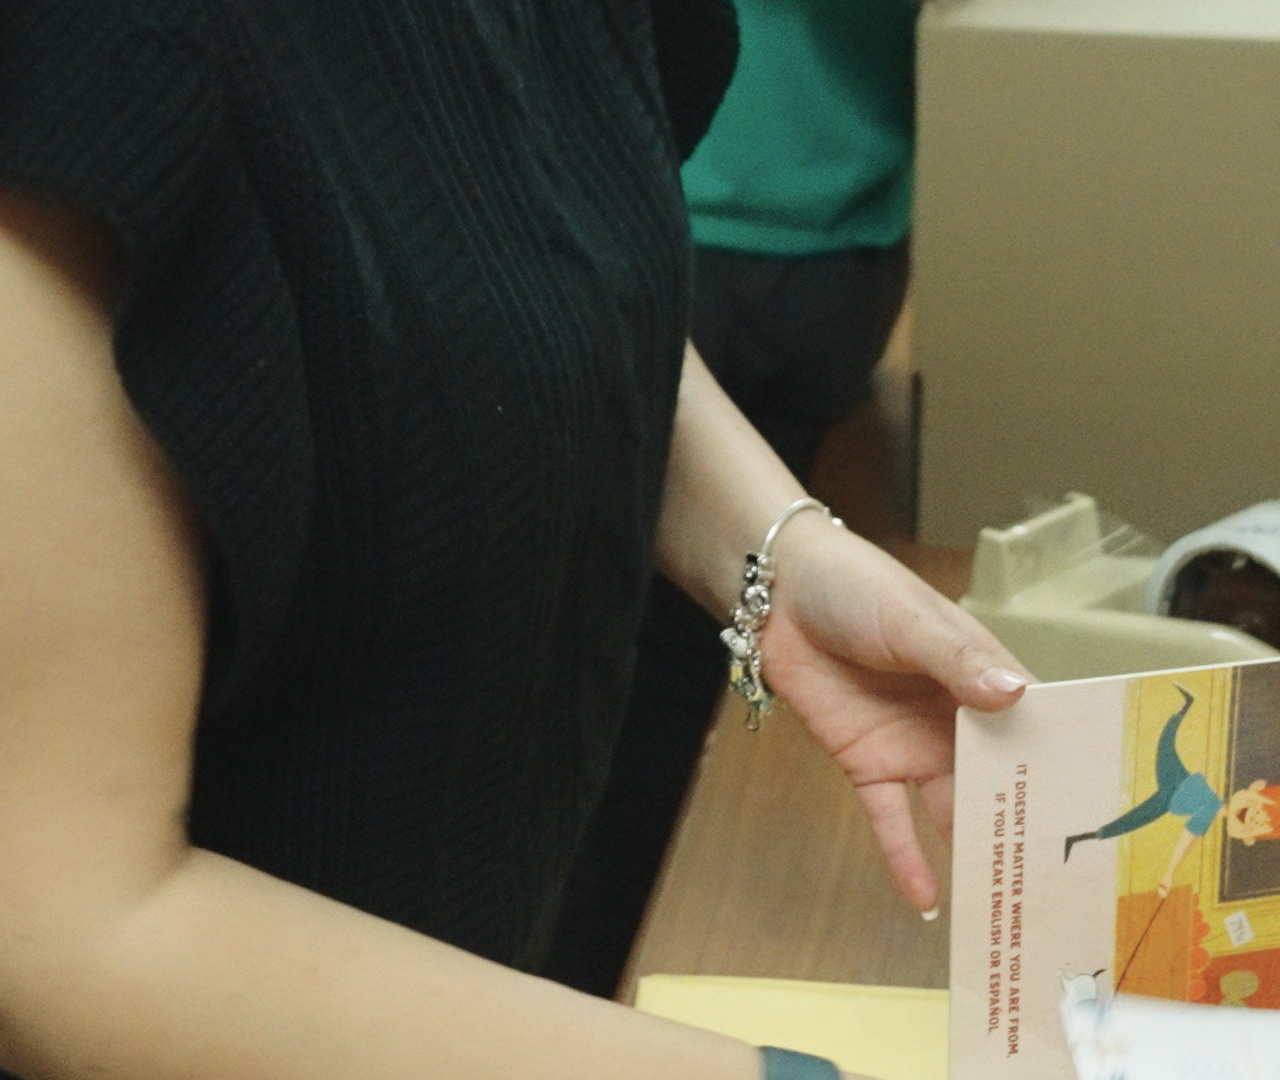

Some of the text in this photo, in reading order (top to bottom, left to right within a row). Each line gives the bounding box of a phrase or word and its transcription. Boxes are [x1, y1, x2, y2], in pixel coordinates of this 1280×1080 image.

[994, 792, 1006, 804] IF
[993, 810, 1006, 838] YOU
[991, 842, 1005, 887] SPEAK
[990, 891, 1003, 946] ENGLISH
[1006, 763, 1027, 1059] IT DOESN'T MATTER WHERE YOU ARE FROM,
[989, 950, 1002, 968] OR
